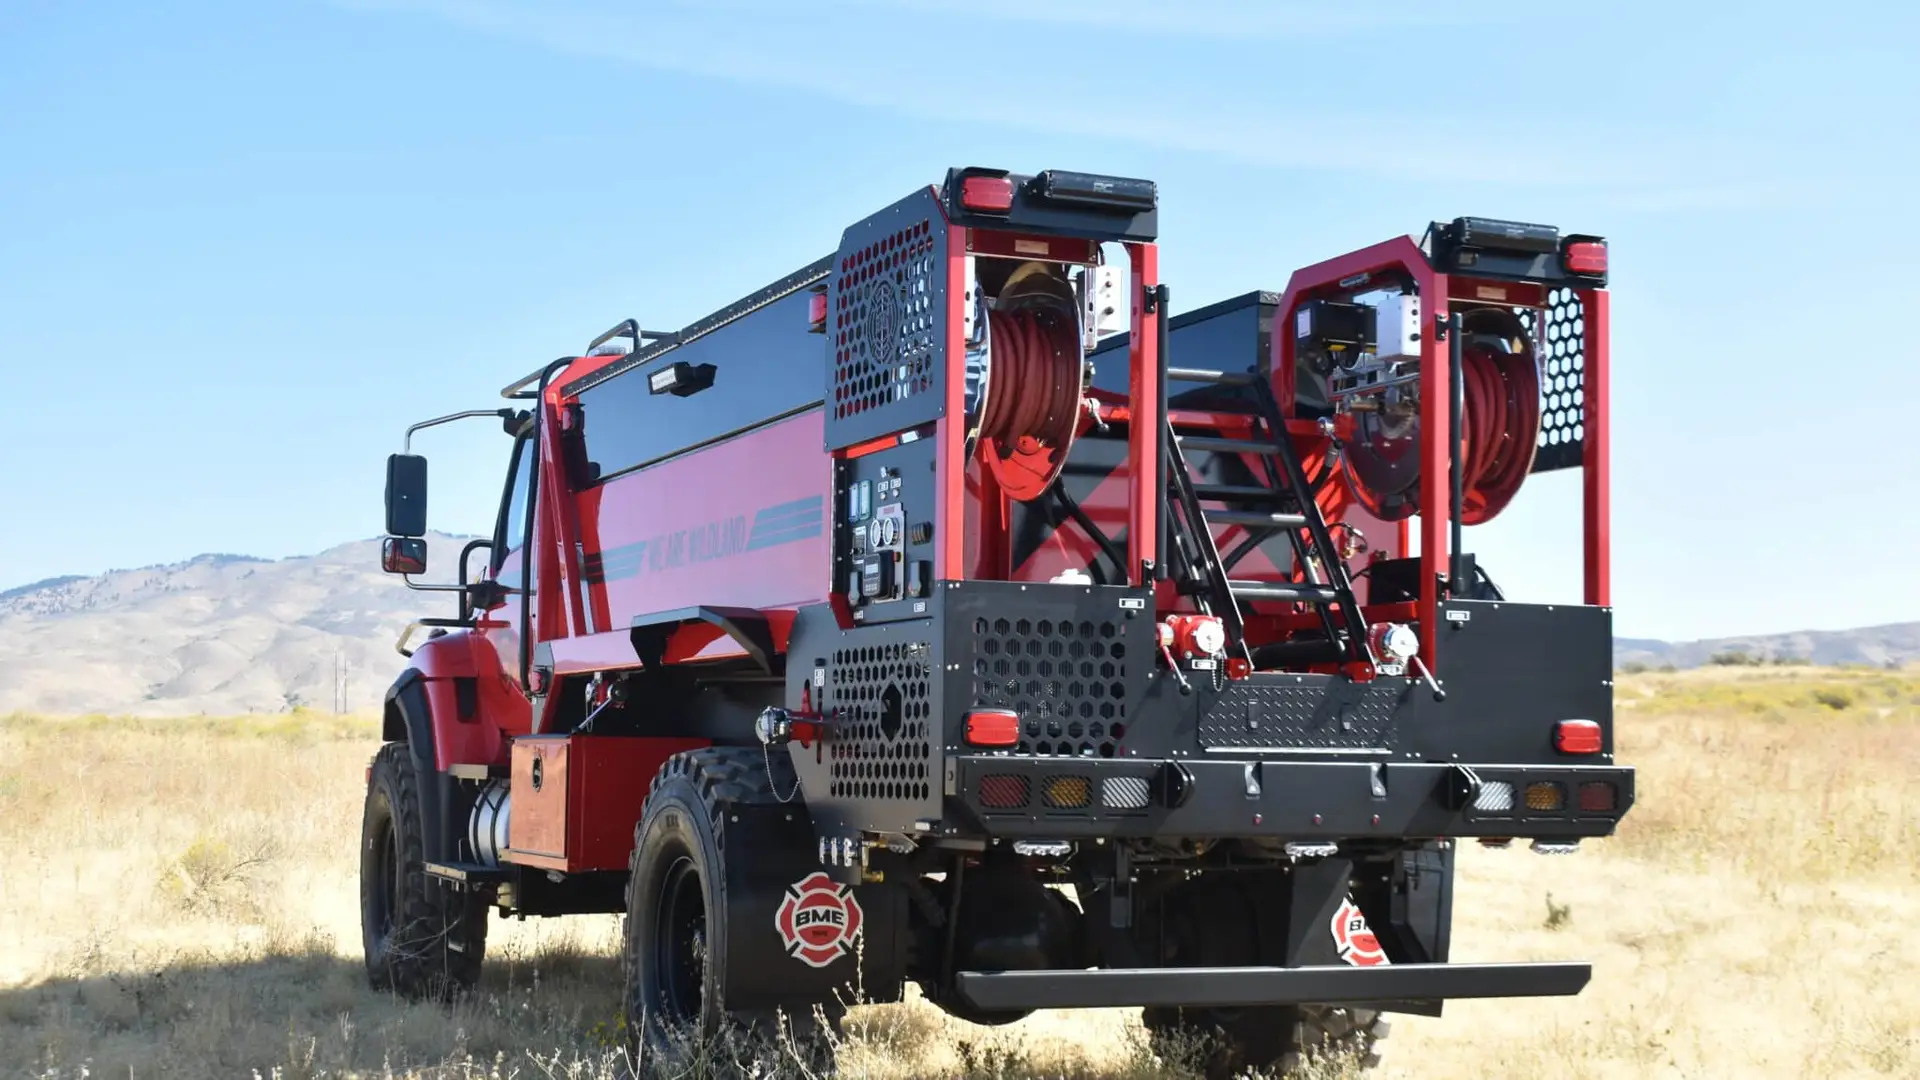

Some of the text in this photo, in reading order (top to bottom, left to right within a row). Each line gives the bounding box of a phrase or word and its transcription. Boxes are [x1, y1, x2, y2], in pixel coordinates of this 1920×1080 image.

[648, 514, 746, 573] WE ARE WILDLAND
[796, 908, 844, 928] BME
